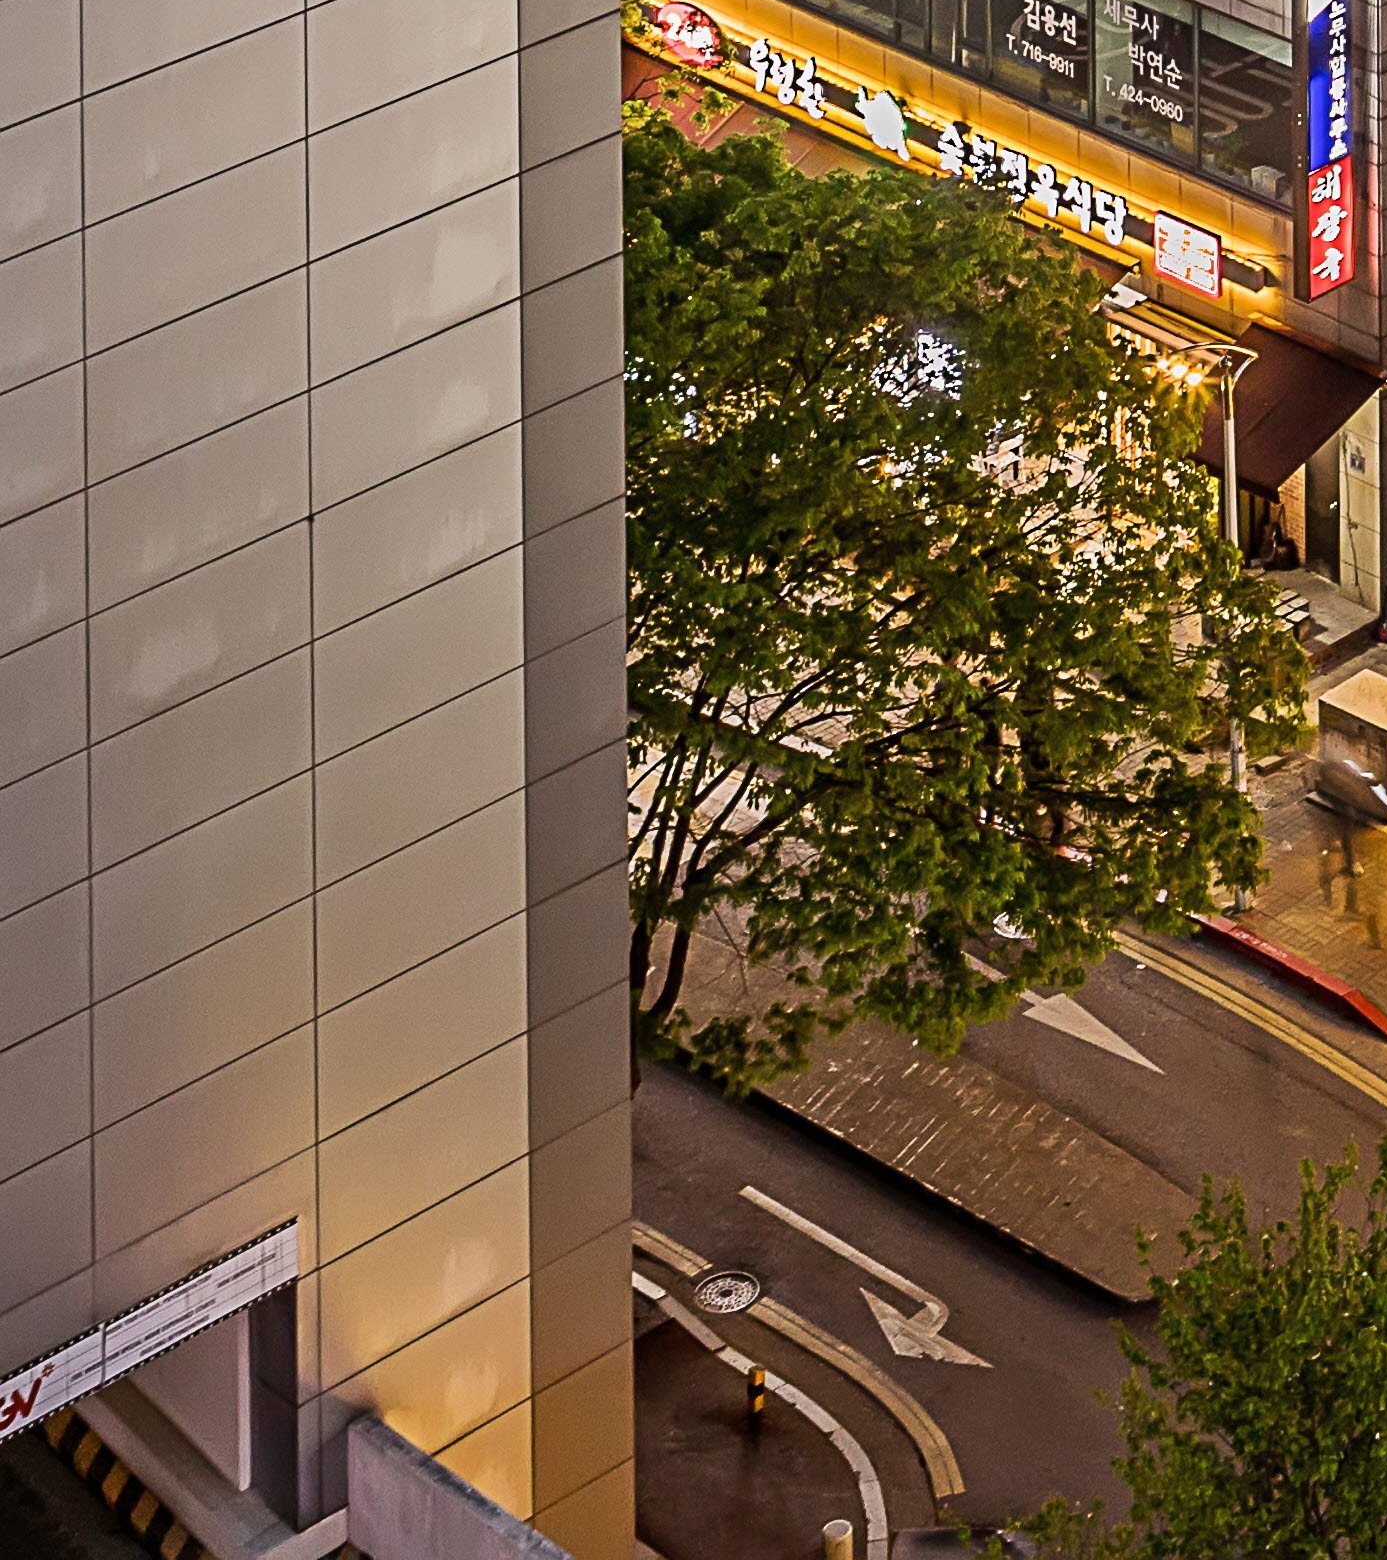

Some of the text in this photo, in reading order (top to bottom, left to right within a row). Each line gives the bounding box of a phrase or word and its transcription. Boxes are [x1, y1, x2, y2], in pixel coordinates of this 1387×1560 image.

[1022, 42, 1075, 78] 716-9911
[1128, 45, 1183, 90] 박연순
[1119, 83, 1184, 123] 424-0960
[1311, 164, 1348, 283] 해장국
